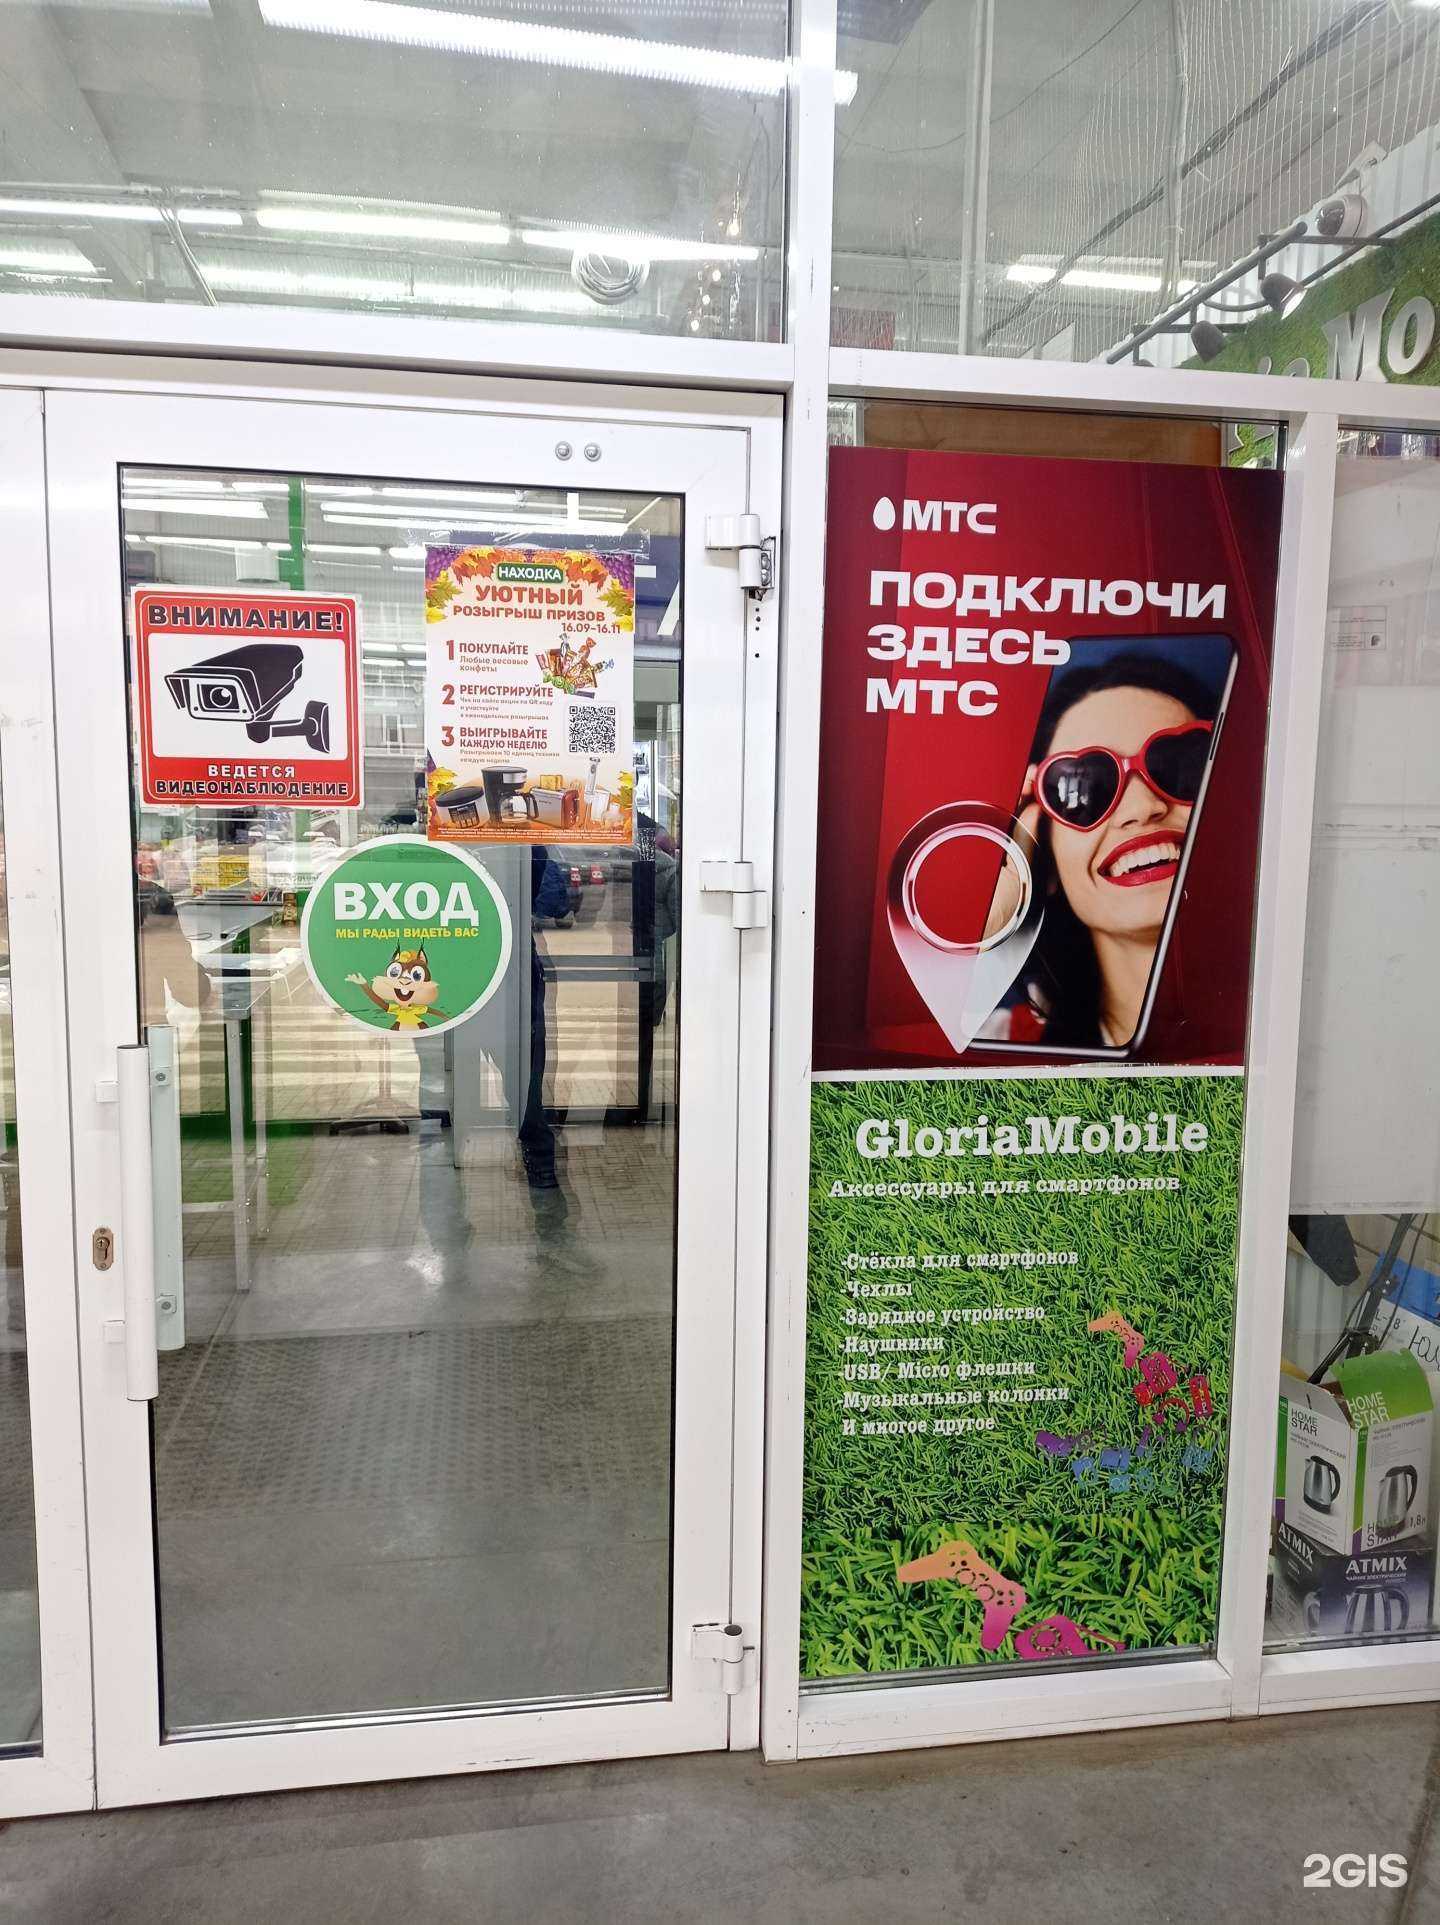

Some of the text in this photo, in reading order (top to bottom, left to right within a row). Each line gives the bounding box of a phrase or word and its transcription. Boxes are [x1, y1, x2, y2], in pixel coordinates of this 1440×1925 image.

[902, 499, 998, 535] МТС
[498, 566, 562, 581] НАХОДКА
[475, 584, 584, 606] УЮТНЫЙ
[869, 570, 1227, 619] ПОДКЛЮЧИ
[147, 604, 345, 633] ВНИМАНИЕ!
[453, 605, 606, 622] РОЗЫГРЫШ ПРИЗОВ
[446, 639, 455, 661] 1
[459, 641, 529, 655] ПОКУПАЙТЕ
[867, 623, 1072, 670] ЗДЕСЬ
[460, 656, 529, 666] Любые весовые
[460, 665, 498, 673] конфеты
[442, 684, 455, 705] 2
[460, 683, 554, 697] РЕГИСТРИРУЙТЕ
[865, 677, 999, 716] МТС
[442, 726, 455, 746] 3
[460, 726, 548, 739] ВЫИГРЫВАЙТЕ
[460, 739, 548, 750] КАЖДУЮ НЕДЕЛЮ
[207, 764, 296, 779] ВЕДЕТСЯ
[155, 780, 348, 797] ВИДЕОНАБЛЮДЕНИЕ
[333, 881, 480, 927] ВХОД
[335, 927, 480, 940] МЫ РАДЫ ВИДЕТЬ ВАС
[856, 1113, 1210, 1160] GloriaMobile
[829, 1175, 1181, 1200] Аксессуары для смартфонов
[922, 1254, 962, 1270] для
[966, 1250, 1079, 1270] смартфонов
[941, 1303, 1046, 1326] устройство
[898, 1362, 950, 1379] Micro
[956, 1361, 1036, 1380] флешки
[988, 1387, 1070, 1403] колонки
[1346, 1391, 1387, 1410] HOME
[842, 1416, 996, 1436] И многое другое
[1291, 1408, 1318, 1427] HOME
[1352, 1407, 1391, 1429] STAR
[1291, 1418, 1318, 1437] STAR
[1278, 1522, 1314, 1565] ATMIX
[1345, 1556, 1408, 1574] ATMIX
